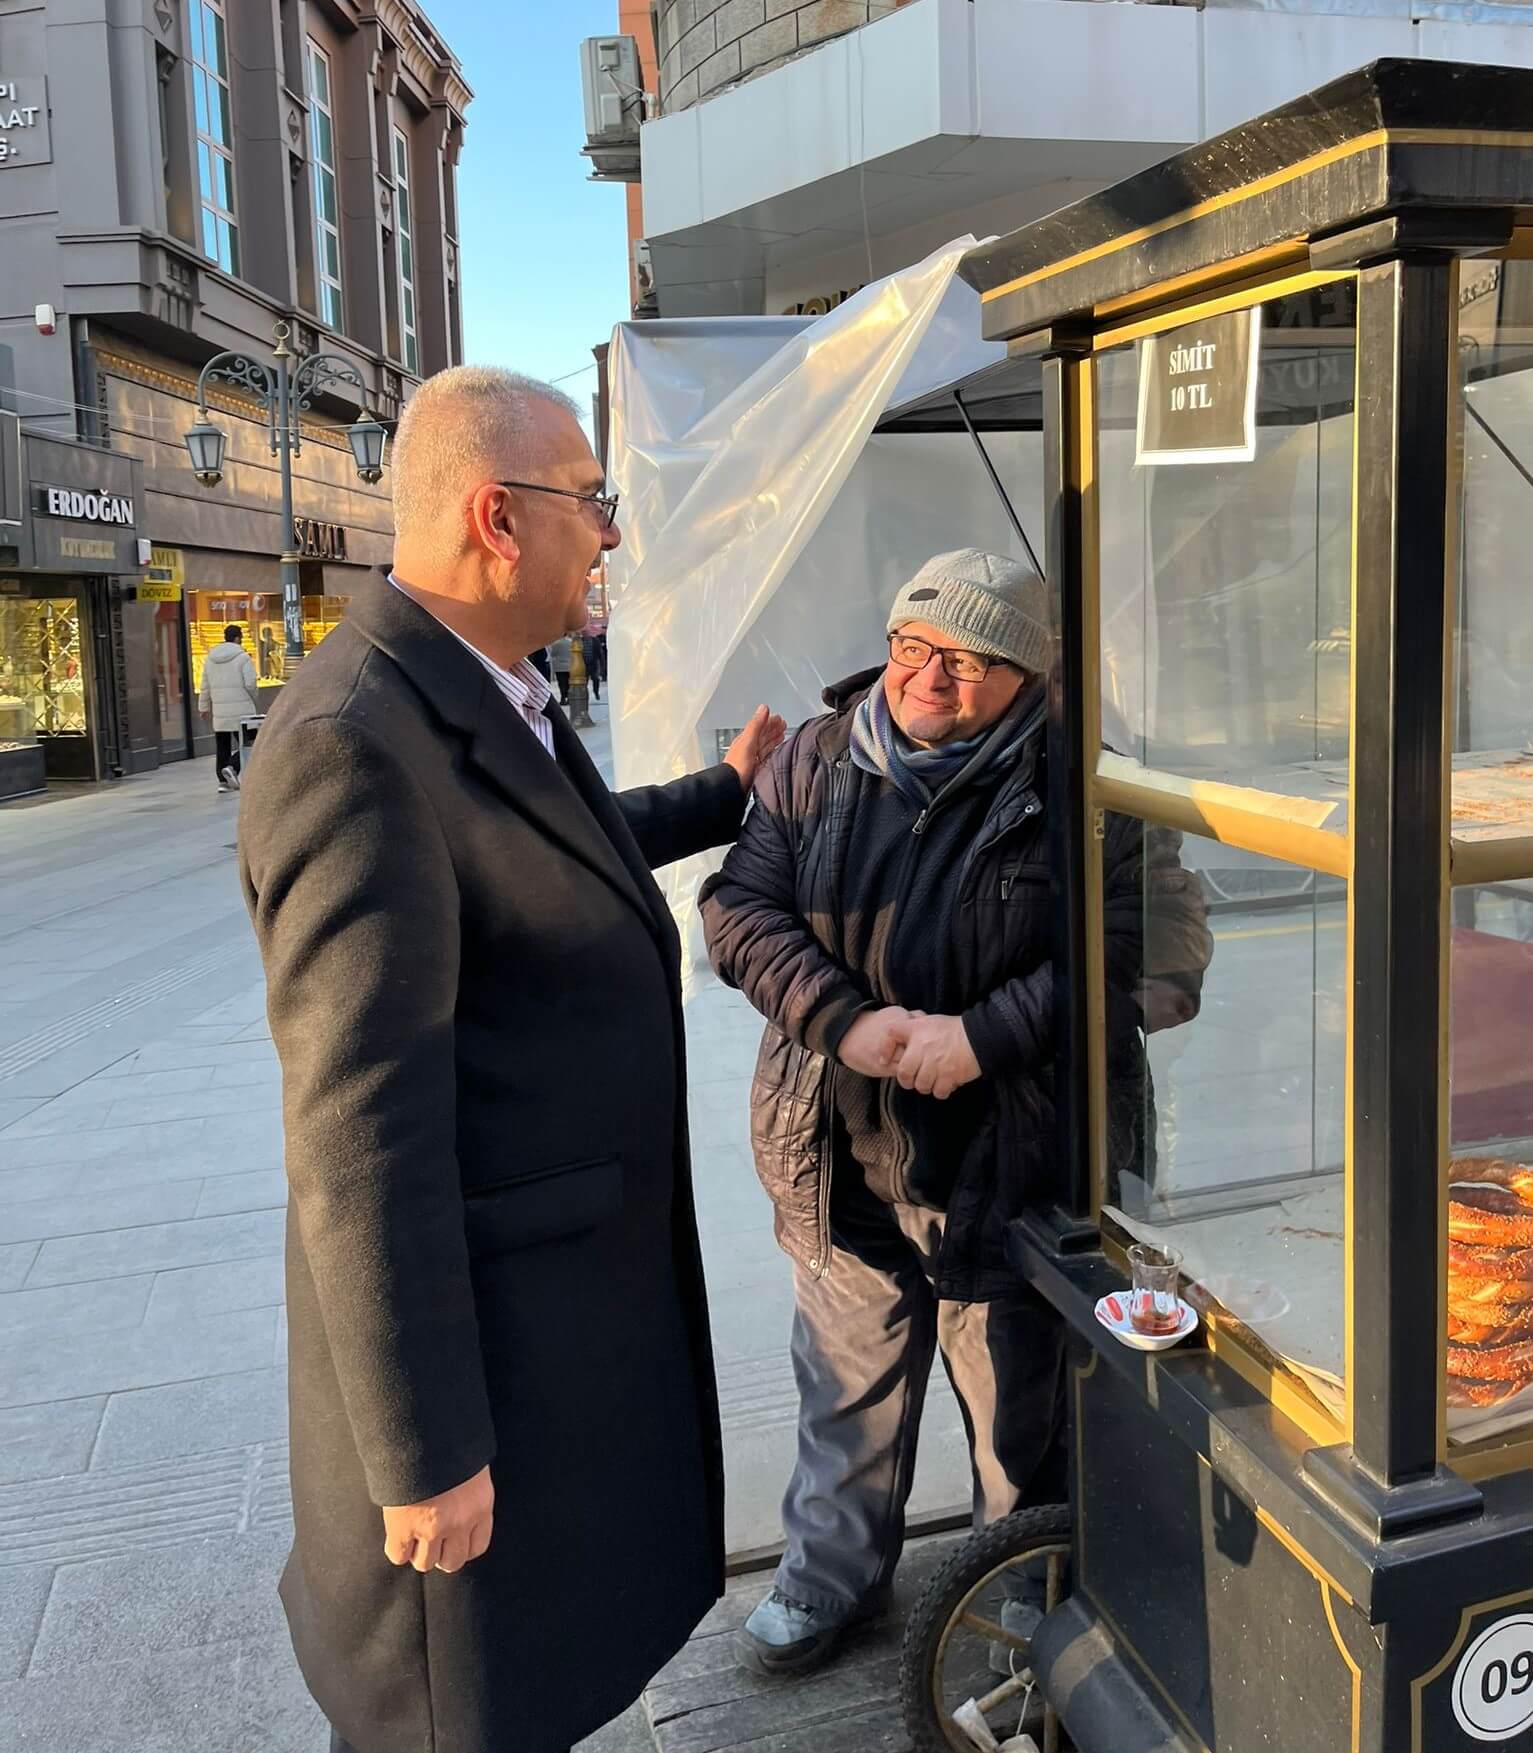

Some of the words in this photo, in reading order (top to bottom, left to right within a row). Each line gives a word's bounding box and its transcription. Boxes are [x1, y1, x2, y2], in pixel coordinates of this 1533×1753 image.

[1169, 339, 1216, 375] SİMİT
[1170, 387, 1185, 411] 10
[1187, 383, 1213, 410] TL
[48, 488, 134, 525] ERDOĞAN
